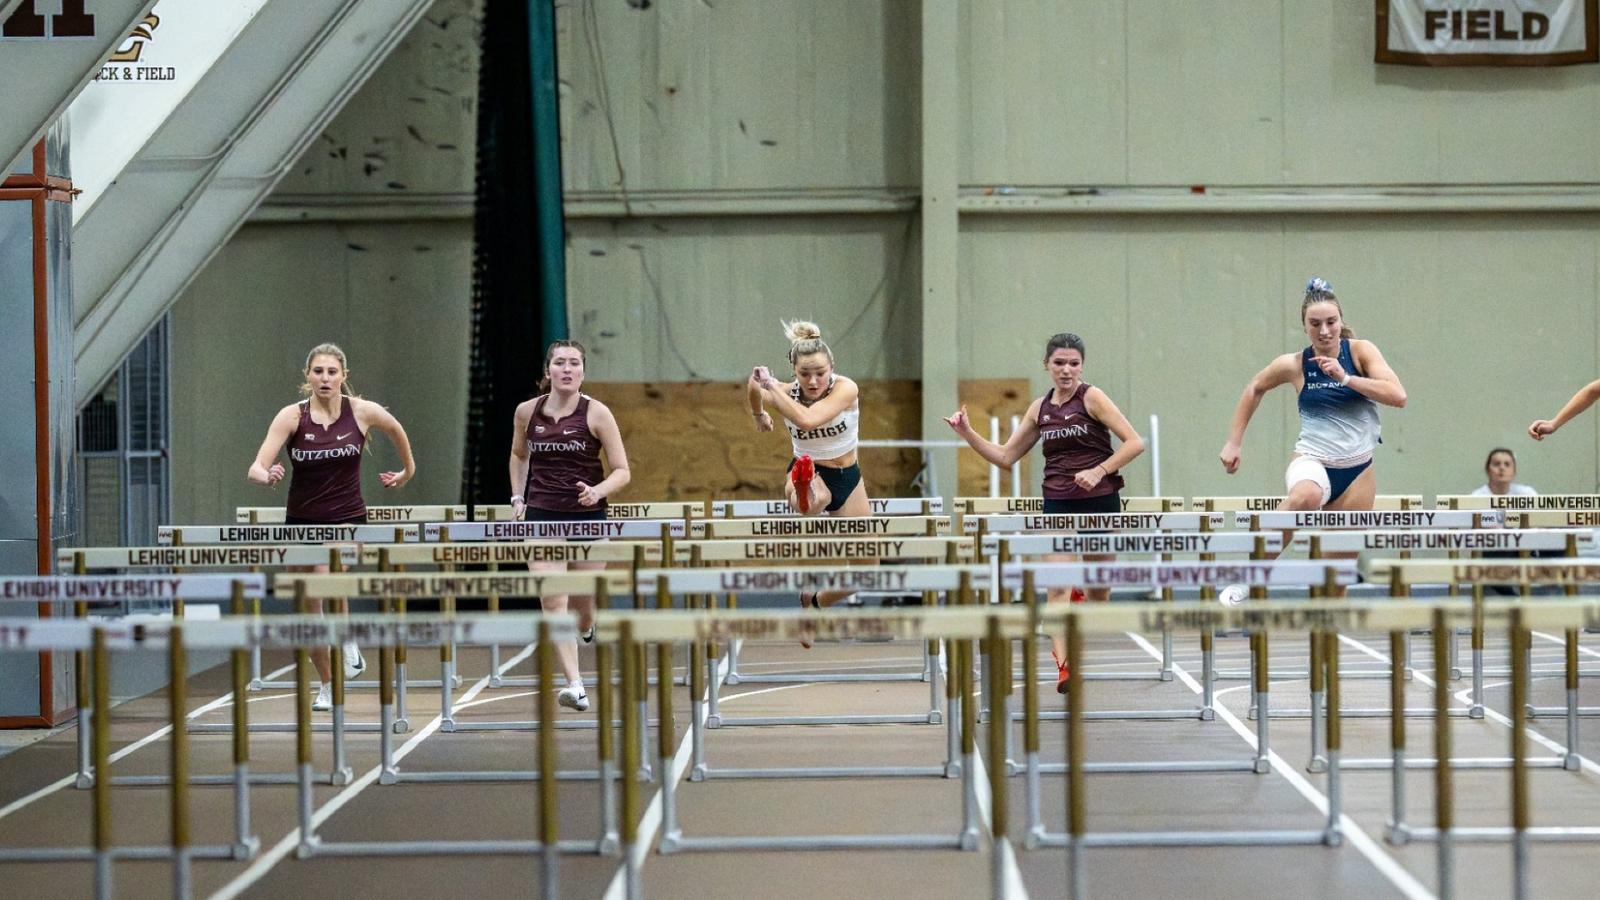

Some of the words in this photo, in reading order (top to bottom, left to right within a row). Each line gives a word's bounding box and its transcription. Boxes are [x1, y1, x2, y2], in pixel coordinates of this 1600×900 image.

[1424, 9, 1550, 41] FIELD
[96, 66, 119, 81] CK
[123, 67, 133, 80] &
[136, 67, 176, 80] FIELD
[291, 443, 361, 462] KUTZTOWN
[606, 504, 651, 518] ERSITY
[1007, 498, 1044, 512] LEHIG
[1490, 496, 1535, 509] LEHIGH
[367, 507, 413, 520] ERSITY
[1024, 515, 1075, 530] LEHIGH
[1078, 513, 1163, 529] UNIVERSITY
[1295, 512, 1346, 527] LEHIGH
[1350, 511, 1436, 527] UNIVERSITY
[1567, 512, 1600, 526] LEHI
[219, 527, 270, 541] LEHIGH
[273, 527, 358, 541] UNIVERSITY
[484, 523, 535, 538] LEHIGH
[538, 522, 625, 537] UNIVERSITY
[752, 520, 802, 535] LEHIGH
[805, 519, 890, 534] UNIVERSITY
[1052, 536, 1110, 552] LEHIGH
[1114, 535, 1212, 551] UNIVERSITY
[1363, 533, 1422, 549] LEHIGH
[1425, 532, 1523, 548] UNIVERSITY
[128, 549, 186, 567] LEHIGH
[190, 548, 287, 565] UNIVERSITY
[432, 546, 490, 562] LEHIGH
[494, 544, 592, 561] UNIVERSITY
[744, 542, 802, 559] LEHIGH
[806, 540, 904, 558] UNIVERSITY
[720, 572, 788, 590] LEHIGH
[793, 570, 907, 589] UNIVERSITY
[1083, 567, 1152, 585] LEHIGH
[1156, 565, 1273, 584] UNIVERSITY
[1, 580, 60, 598] EHIGH
[65, 579, 181, 597] UNIVERSITY
[357, 577, 426, 596] LEHIGH
[430, 576, 545, 594] UNIVERSITY
